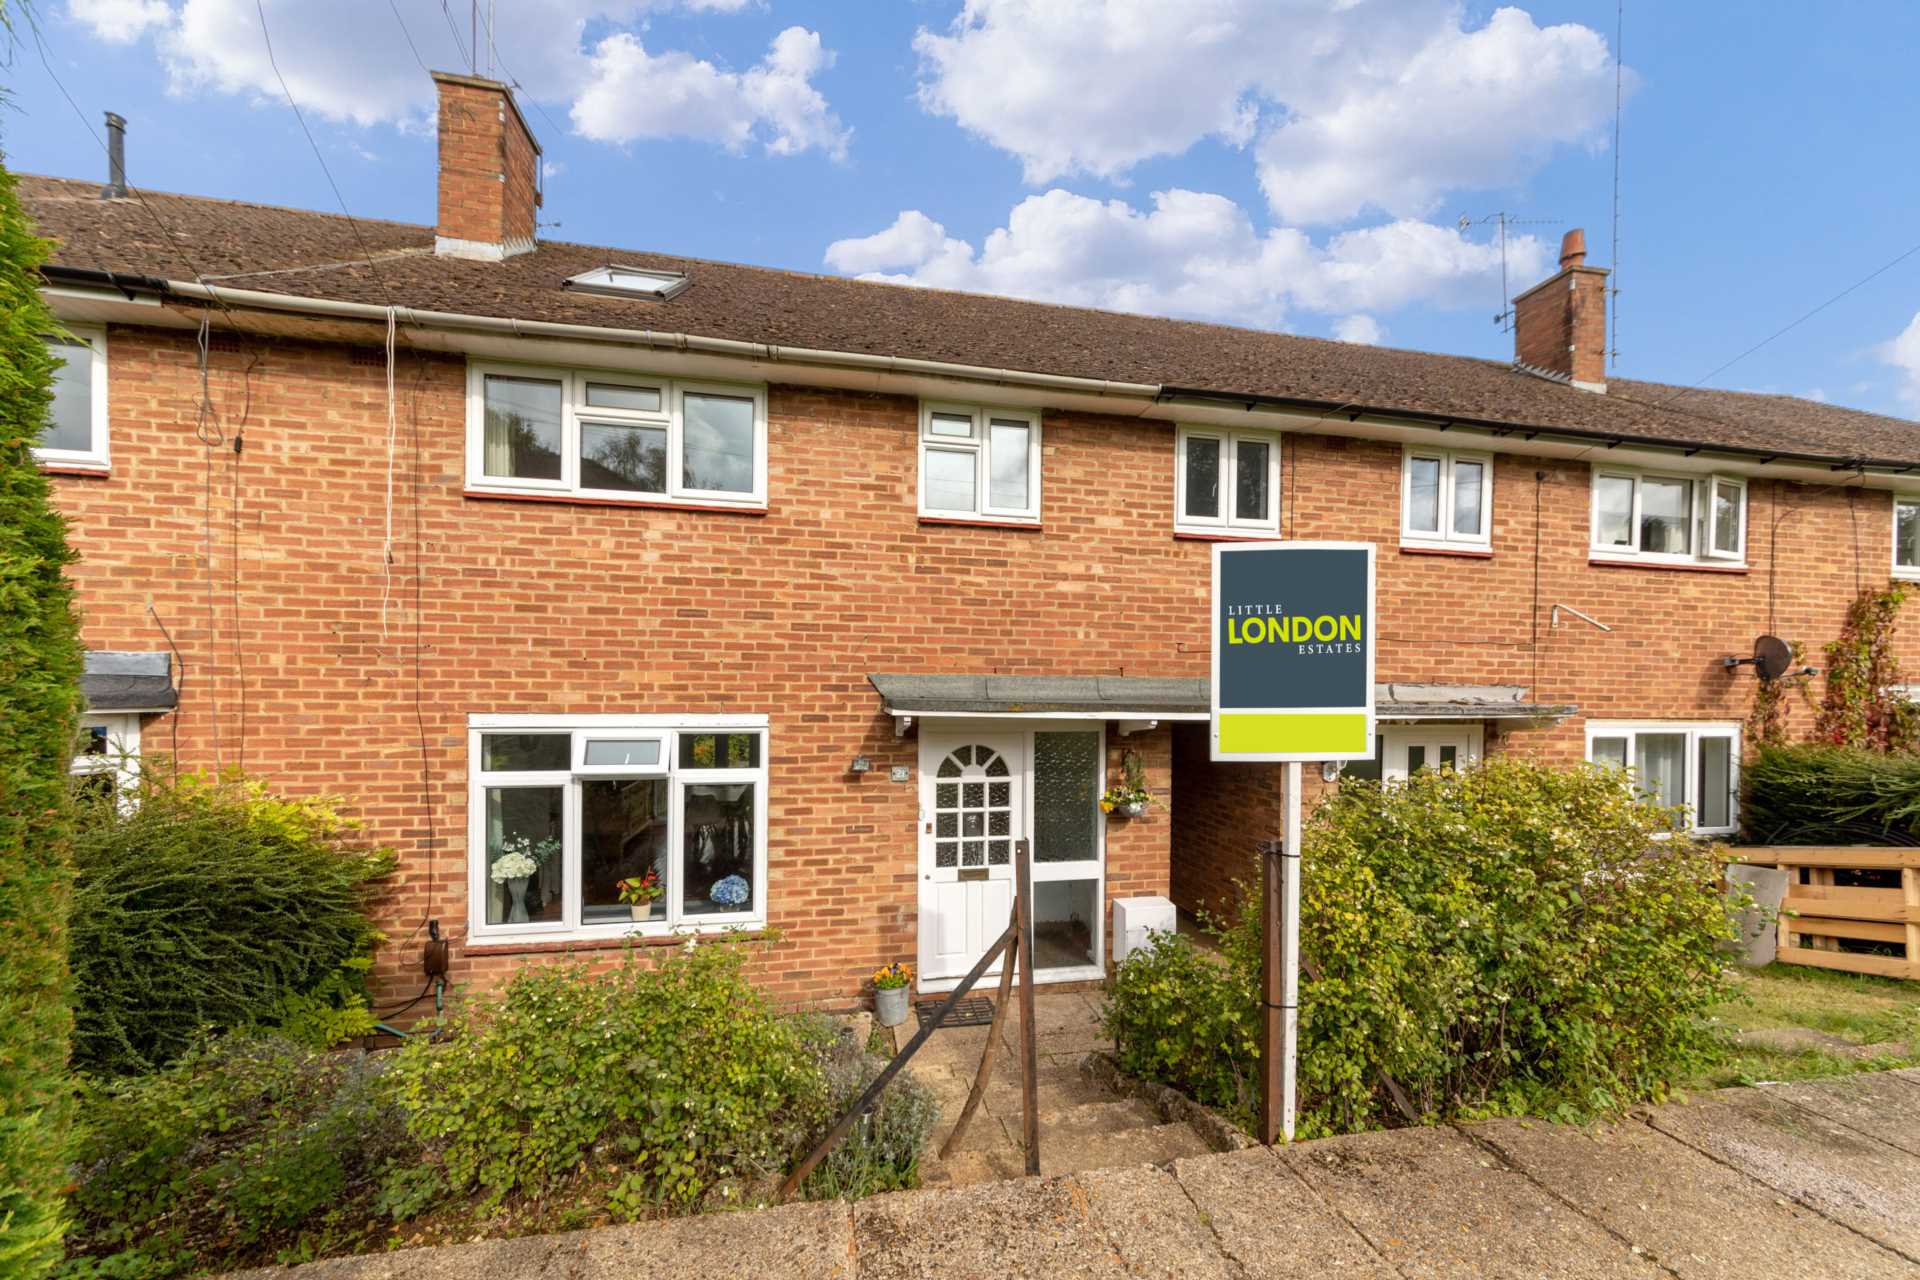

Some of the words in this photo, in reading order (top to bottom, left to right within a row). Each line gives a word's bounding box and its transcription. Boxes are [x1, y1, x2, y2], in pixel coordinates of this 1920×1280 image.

[1228, 604, 1283, 615] LITTLE
[1228, 615, 1361, 644] LONDON
[1299, 643, 1361, 655] ESTATES
